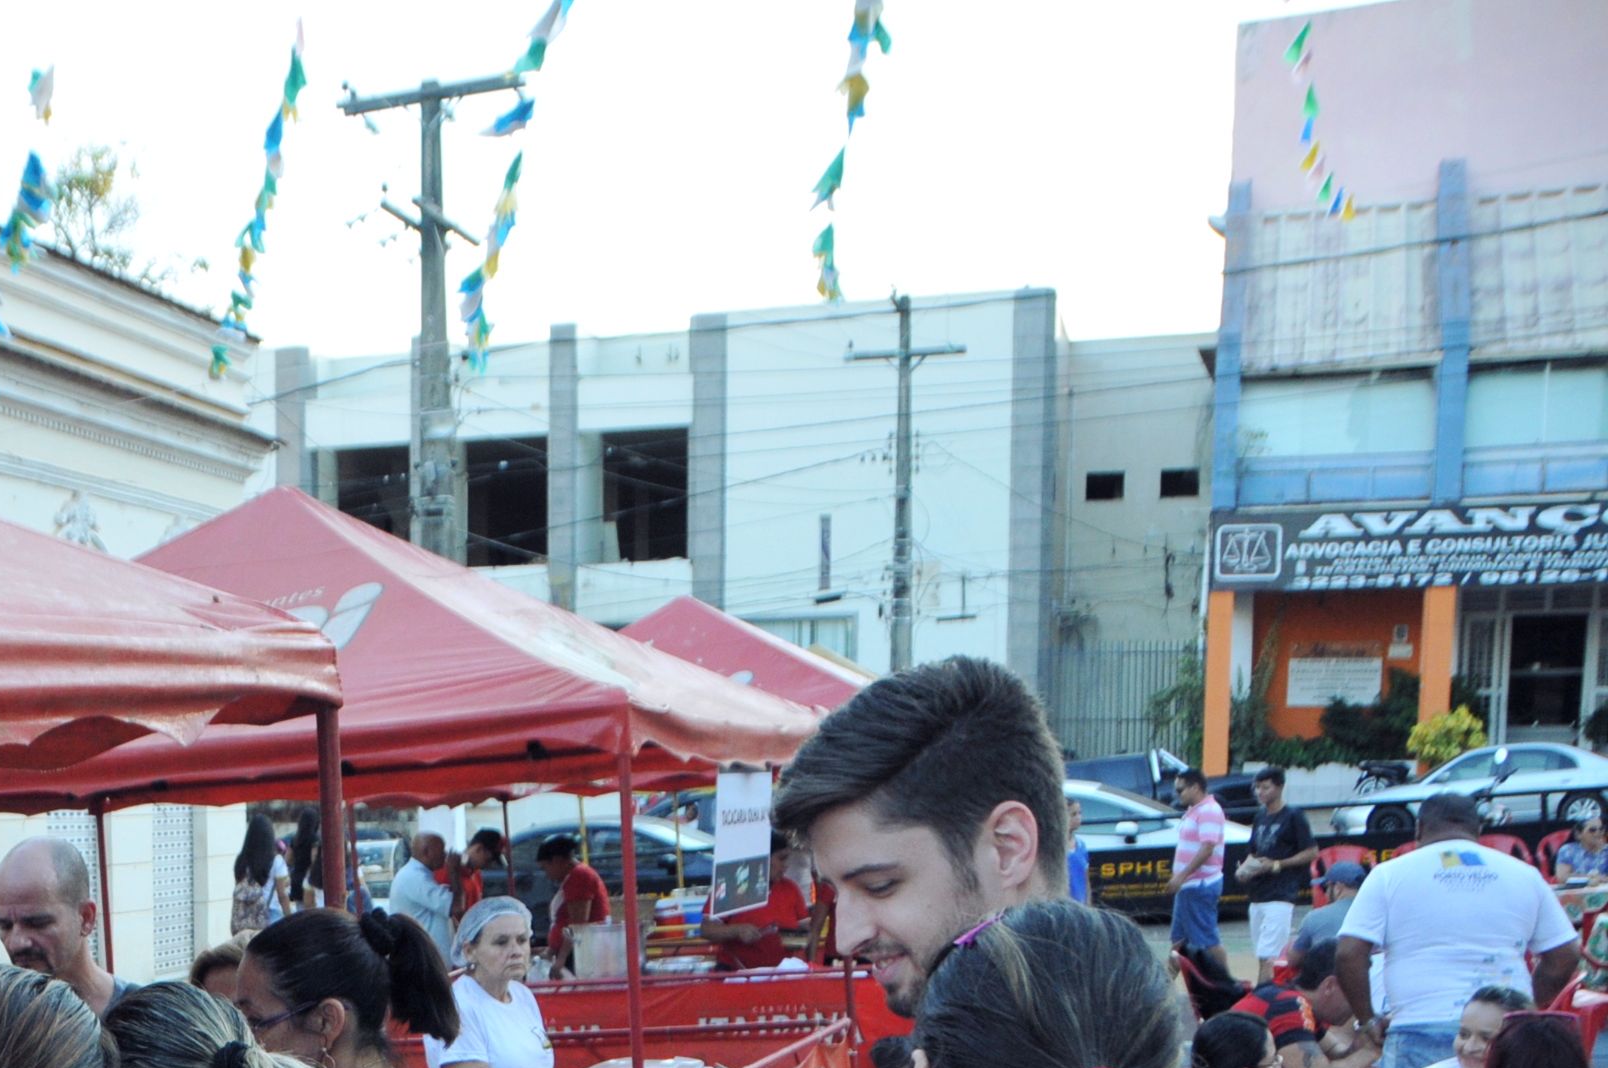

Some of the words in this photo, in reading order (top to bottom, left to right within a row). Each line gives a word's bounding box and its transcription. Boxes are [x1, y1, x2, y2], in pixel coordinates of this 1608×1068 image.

[1284, 539, 1402, 560] ADVOCACIA
[1406, 538, 1422, 555] E
[1425, 534, 1578, 556] CONSULTORIA
[1100, 860, 1171, 878] SPHE
